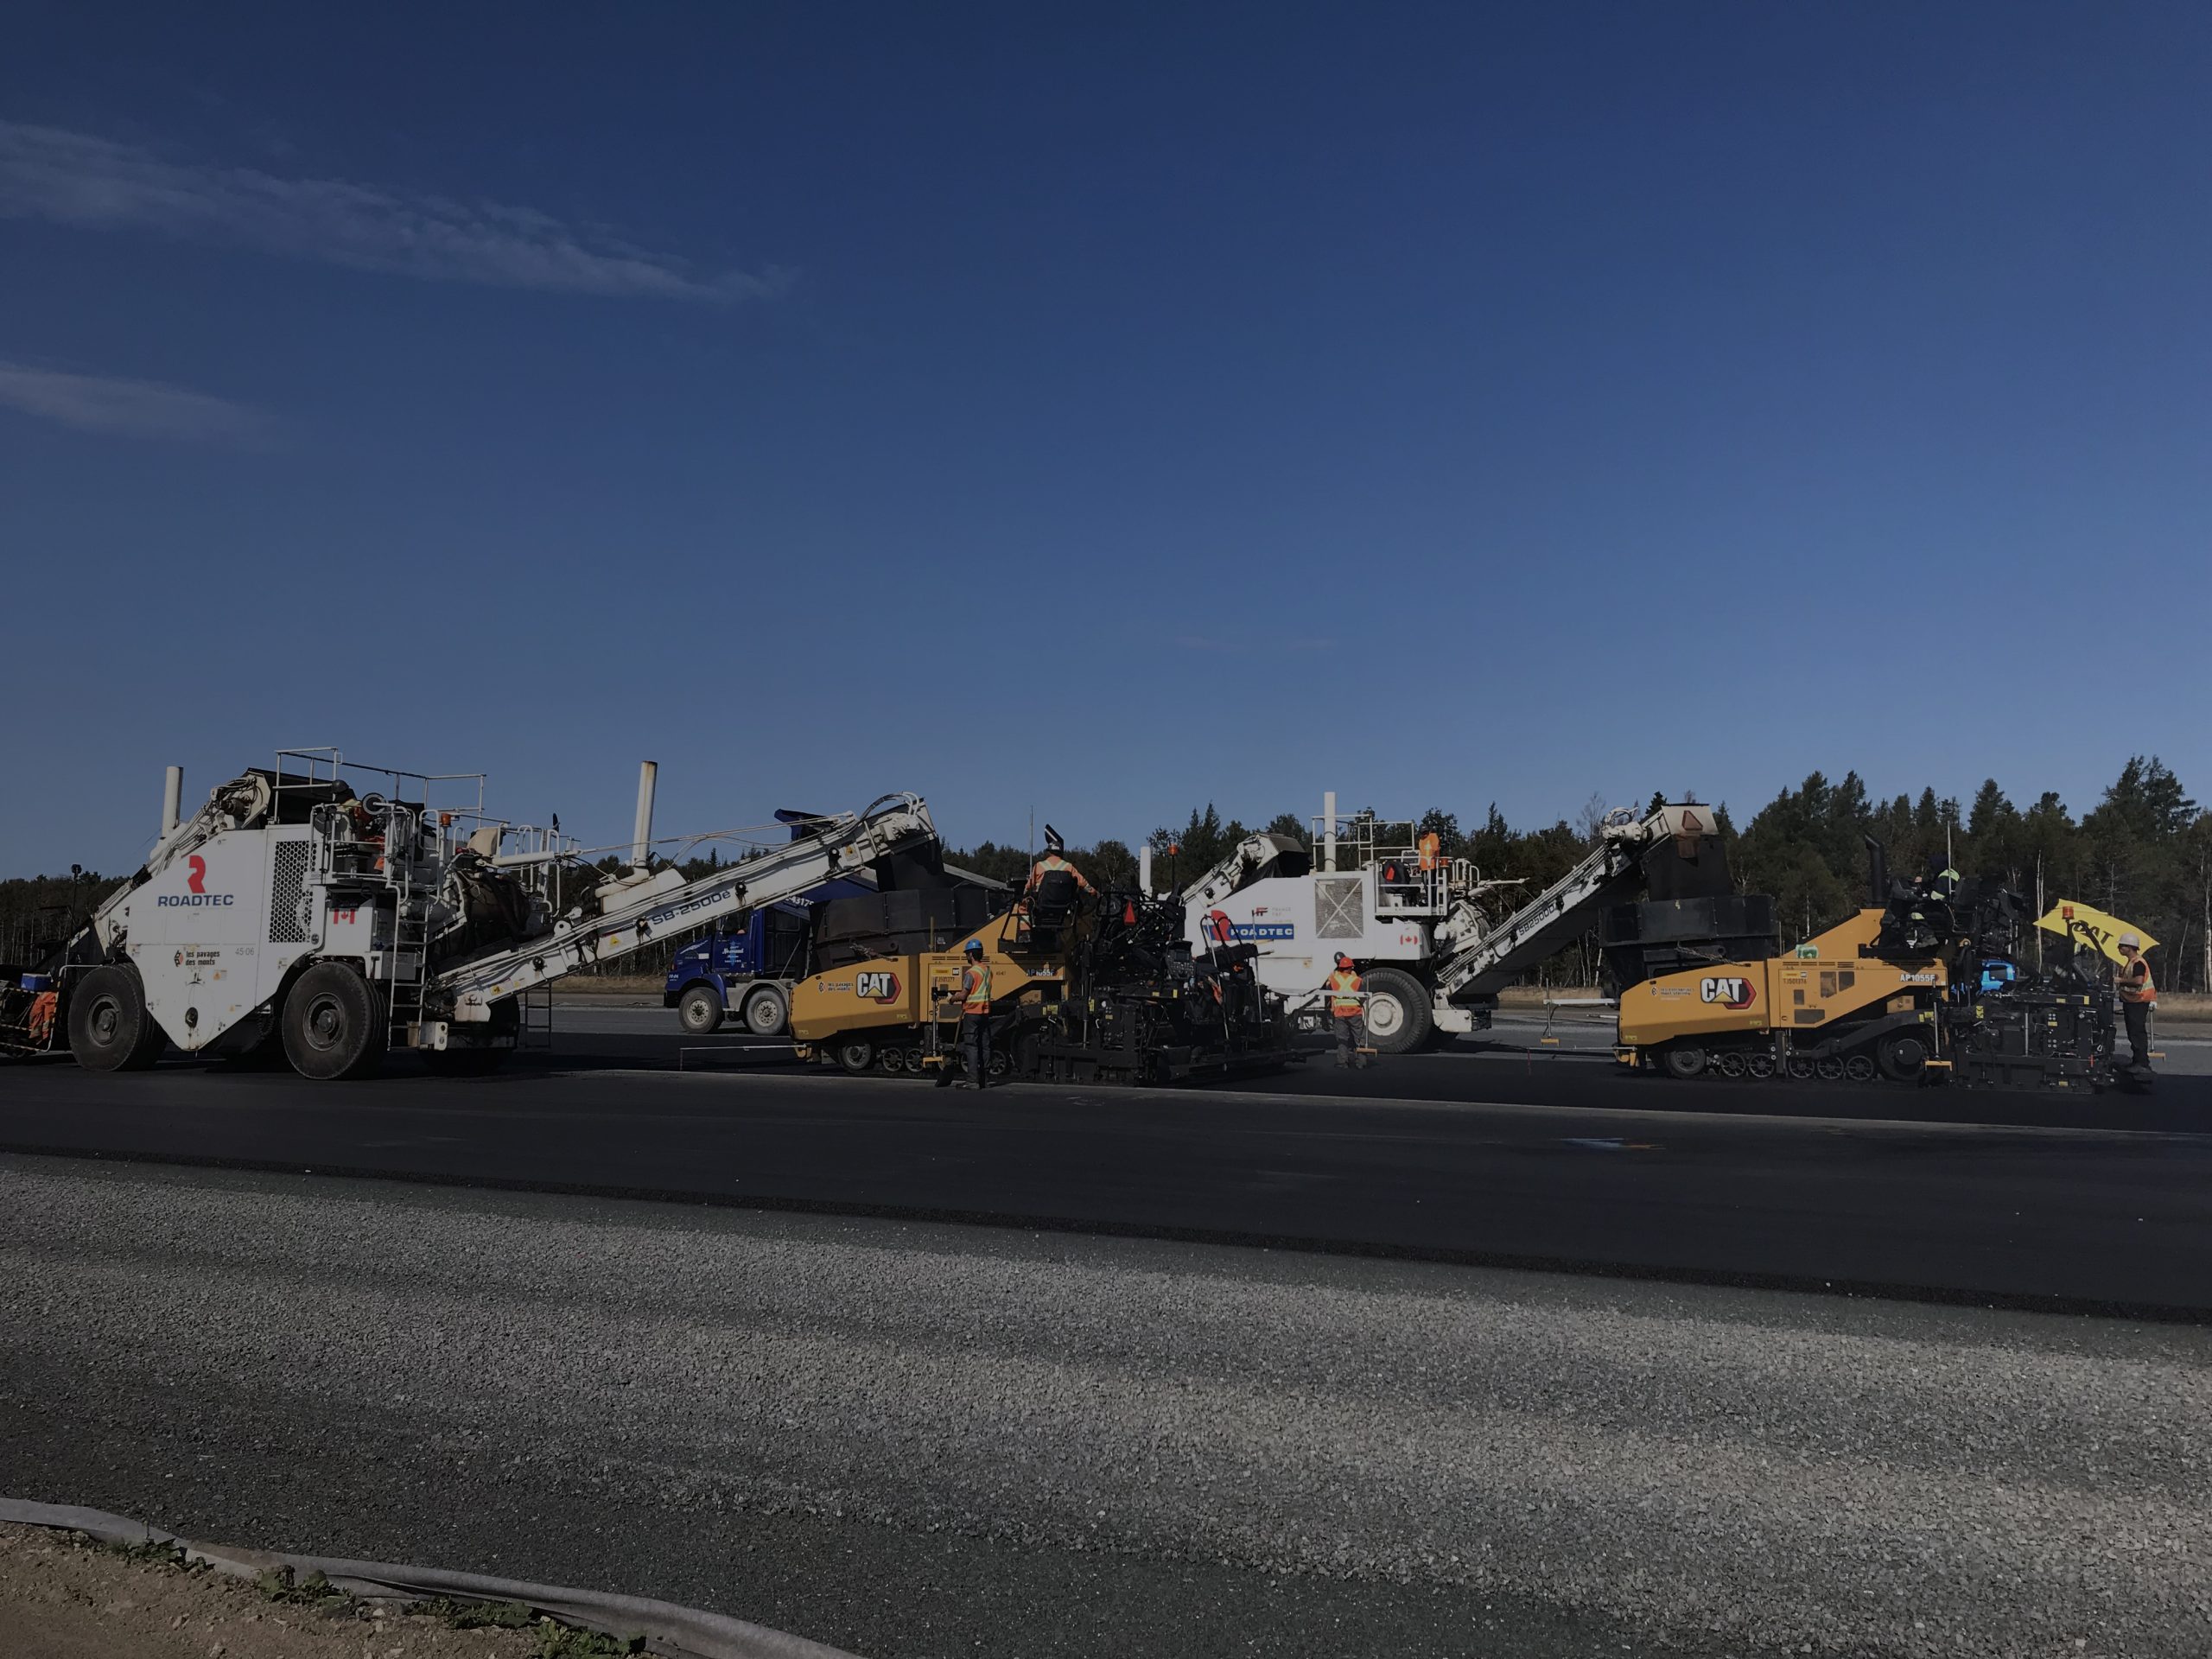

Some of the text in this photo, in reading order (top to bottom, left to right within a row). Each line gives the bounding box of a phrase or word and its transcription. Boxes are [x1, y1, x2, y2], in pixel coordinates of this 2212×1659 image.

[157, 894, 234, 907] ROADTEC
[652, 890, 731, 925] SB-2500e
[196, 950, 220, 959] pavages
[857, 972, 891, 997] CAT
[1899, 974, 1936, 982] AP1055F
[1700, 978, 1743, 1002] CAT
